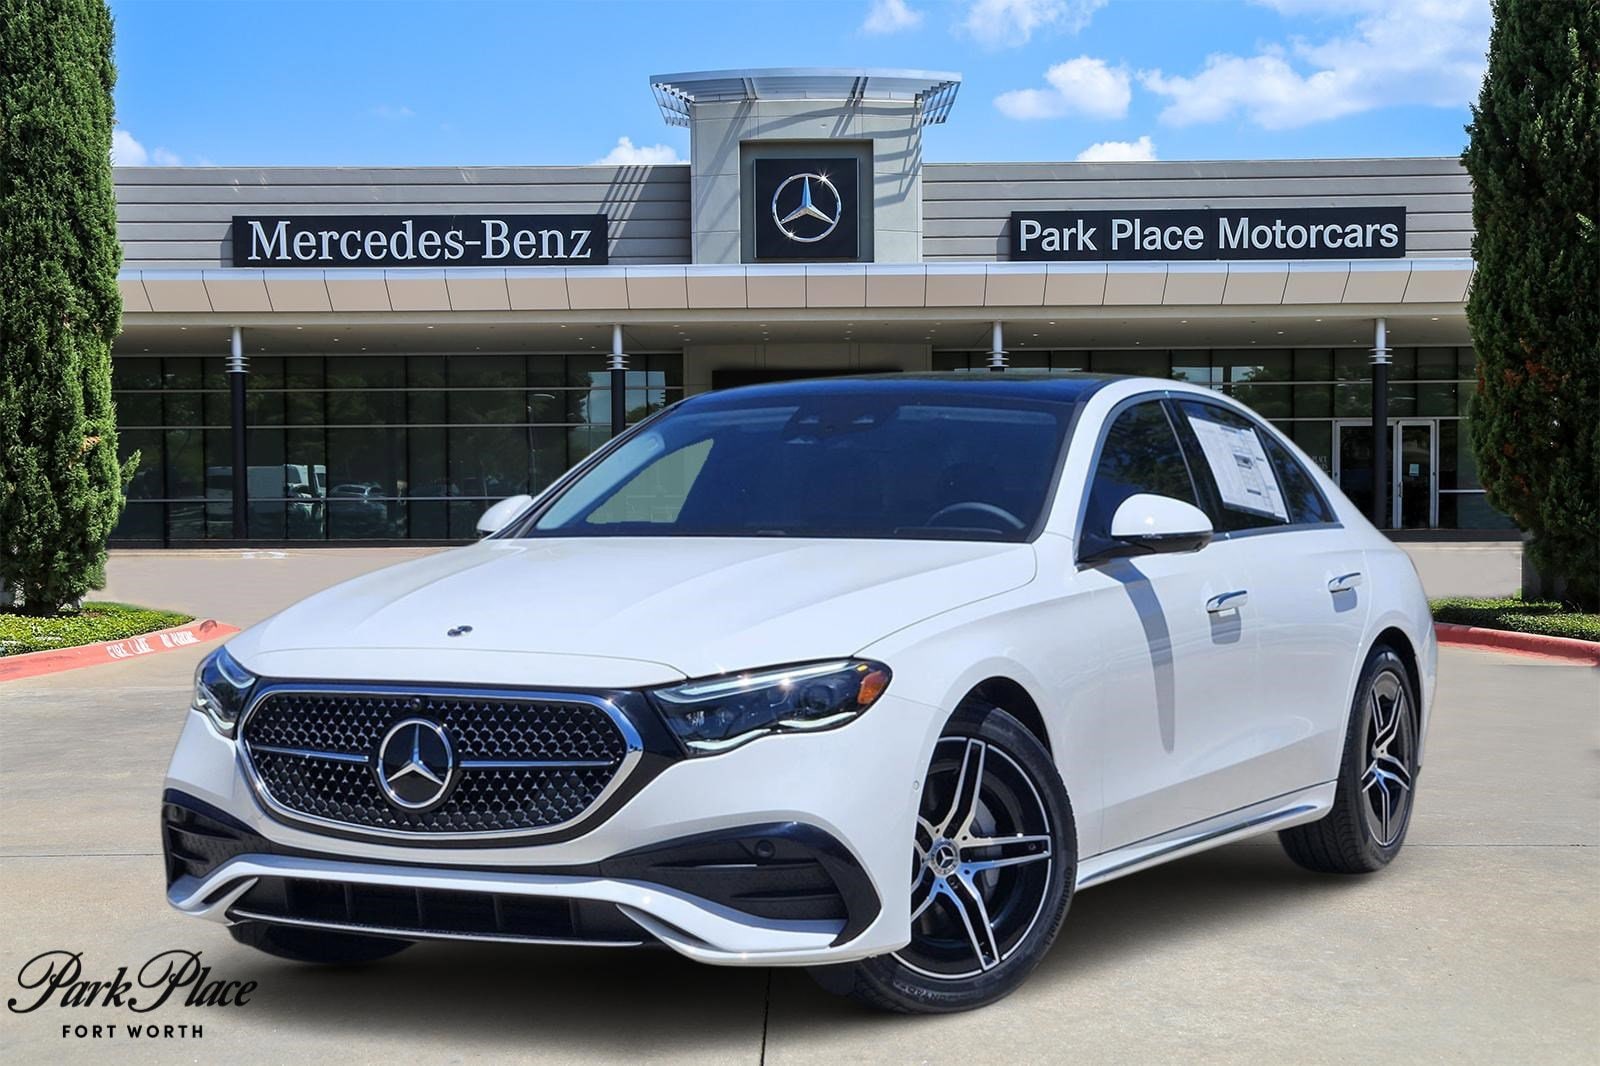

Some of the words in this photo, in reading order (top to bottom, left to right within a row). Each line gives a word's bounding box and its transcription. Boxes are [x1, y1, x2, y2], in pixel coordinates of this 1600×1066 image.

[247, 219, 592, 261] Mercedes-Benz
[1020, 219, 1098, 252] Park
[1111, 218, 1204, 251] Place
[1218, 217, 1399, 249] Motorcars
